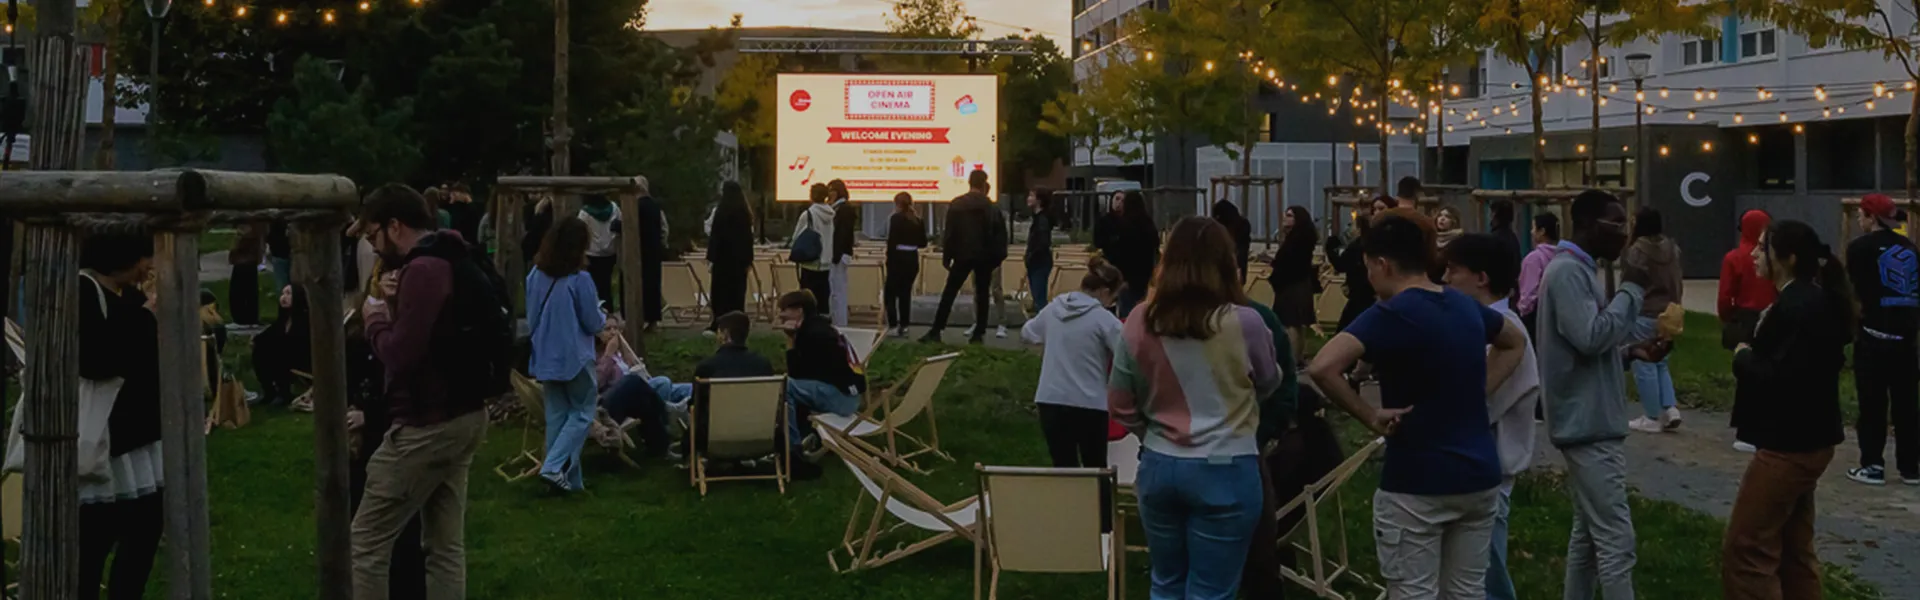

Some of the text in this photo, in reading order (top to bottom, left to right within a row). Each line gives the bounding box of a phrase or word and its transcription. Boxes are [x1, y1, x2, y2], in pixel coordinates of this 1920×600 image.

[868, 90, 913, 99] OPEN AIR
[870, 101, 911, 109] CINEMA
[841, 131, 933, 140] WELCOME EVENING
[1680, 172, 1712, 207] C
